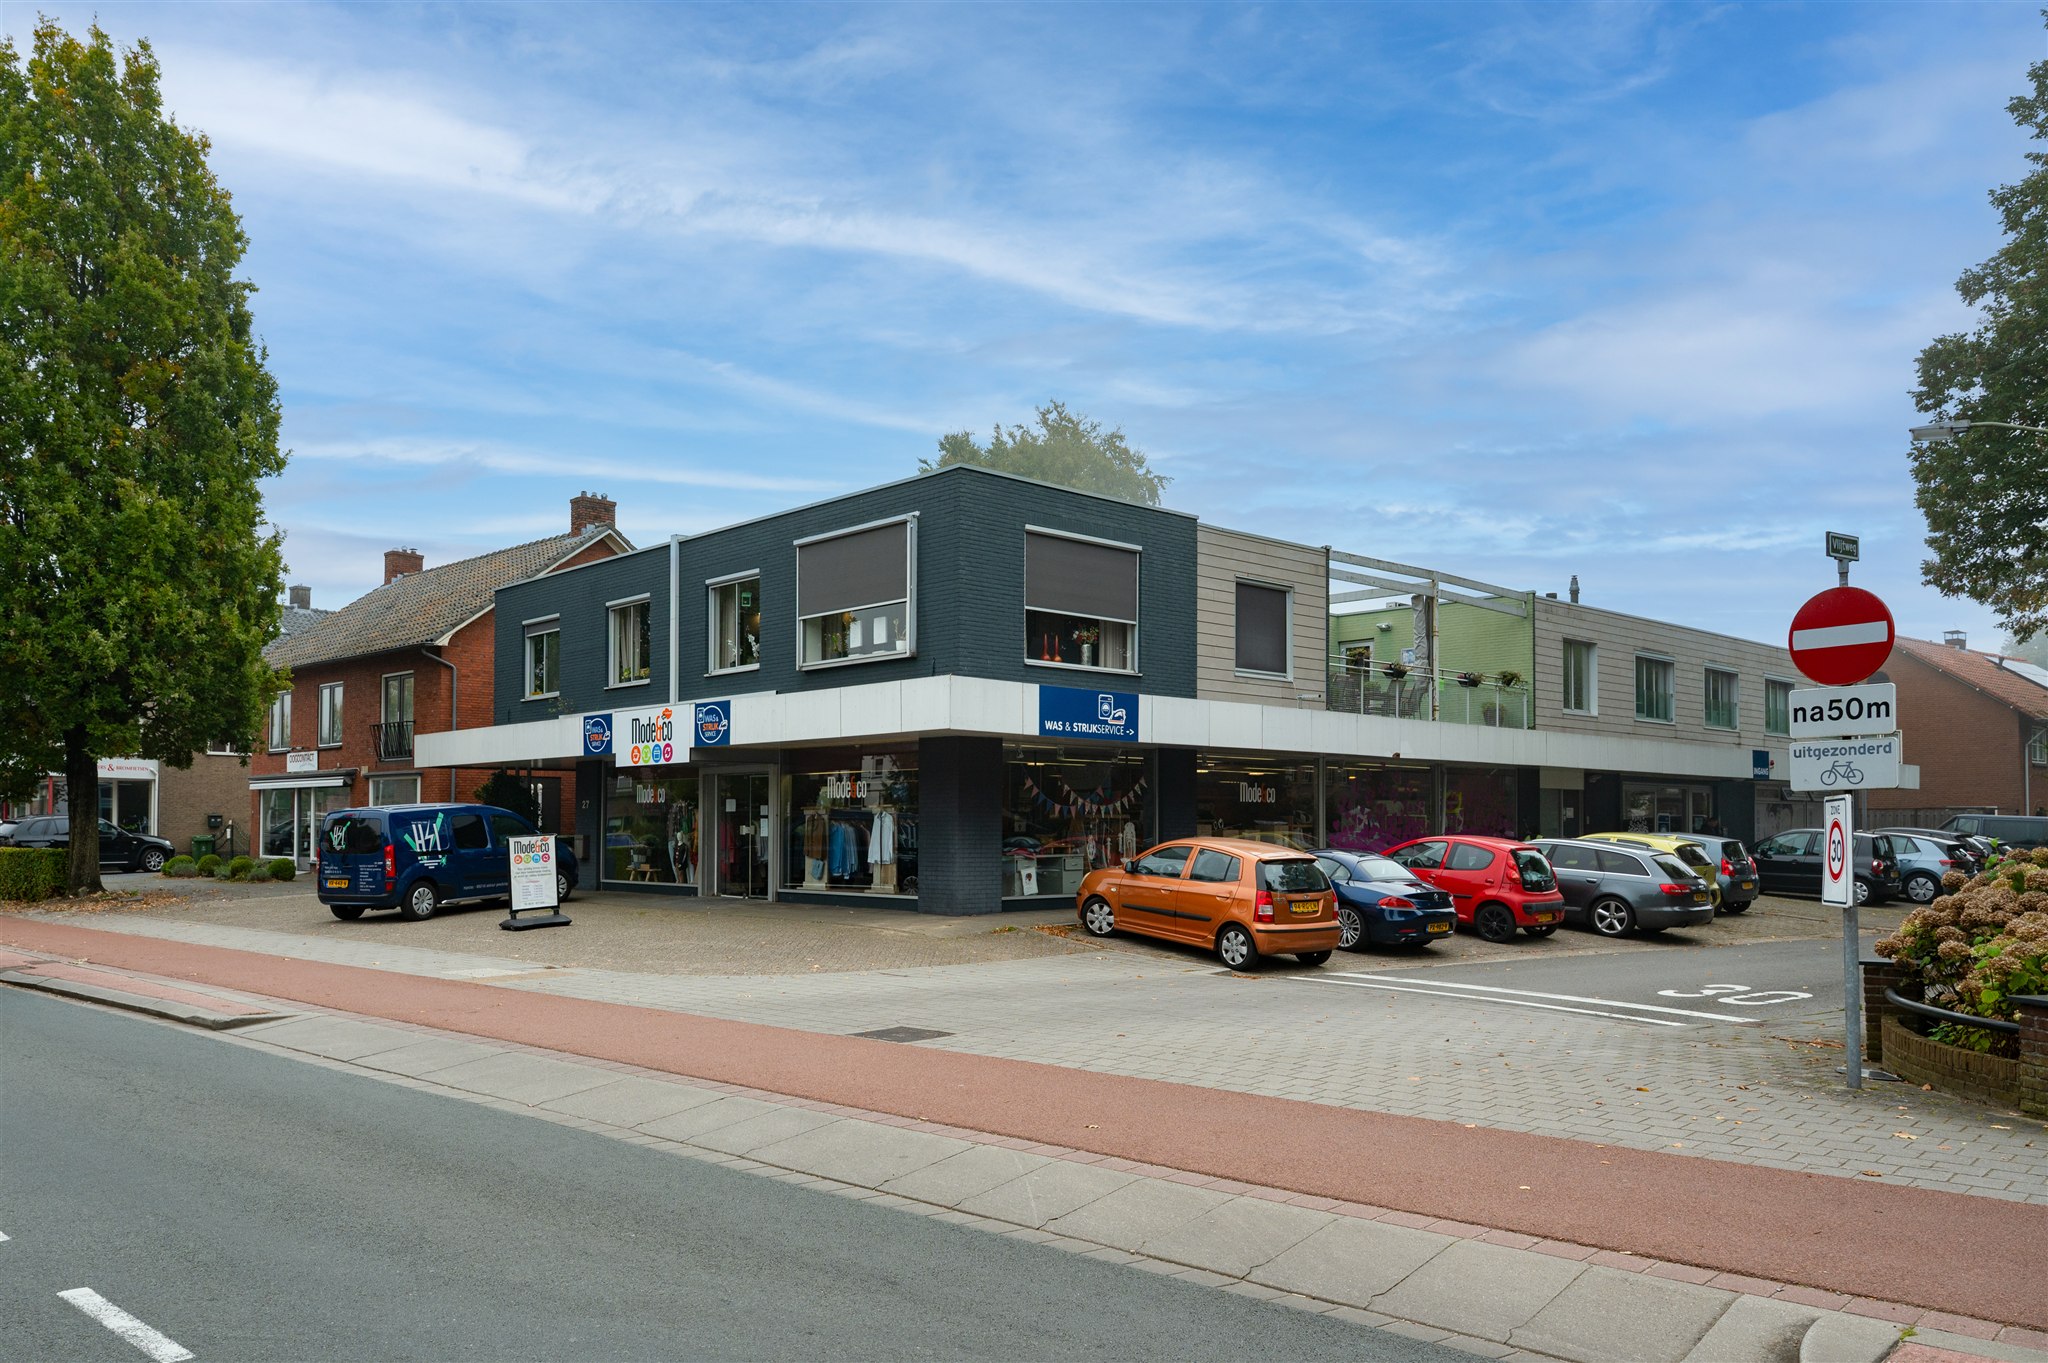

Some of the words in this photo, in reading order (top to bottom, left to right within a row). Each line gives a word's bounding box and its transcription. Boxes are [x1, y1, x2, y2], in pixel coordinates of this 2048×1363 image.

[1832, 538, 1857, 556] Vlijtweg
[703, 722, 719, 731] STRIJK
[1044, 720, 1063, 731] WAS
[1065, 722, 1071, 732] &
[1073, 722, 1125, 735] STRIJKSERVICE
[1793, 742, 1892, 760] uitgezonderd
[581, 799, 590, 809] 27
[1830, 805, 1841, 815] ZONE
[1831, 840, 1842, 863] 30
[1657, 984, 1813, 1005] 30
